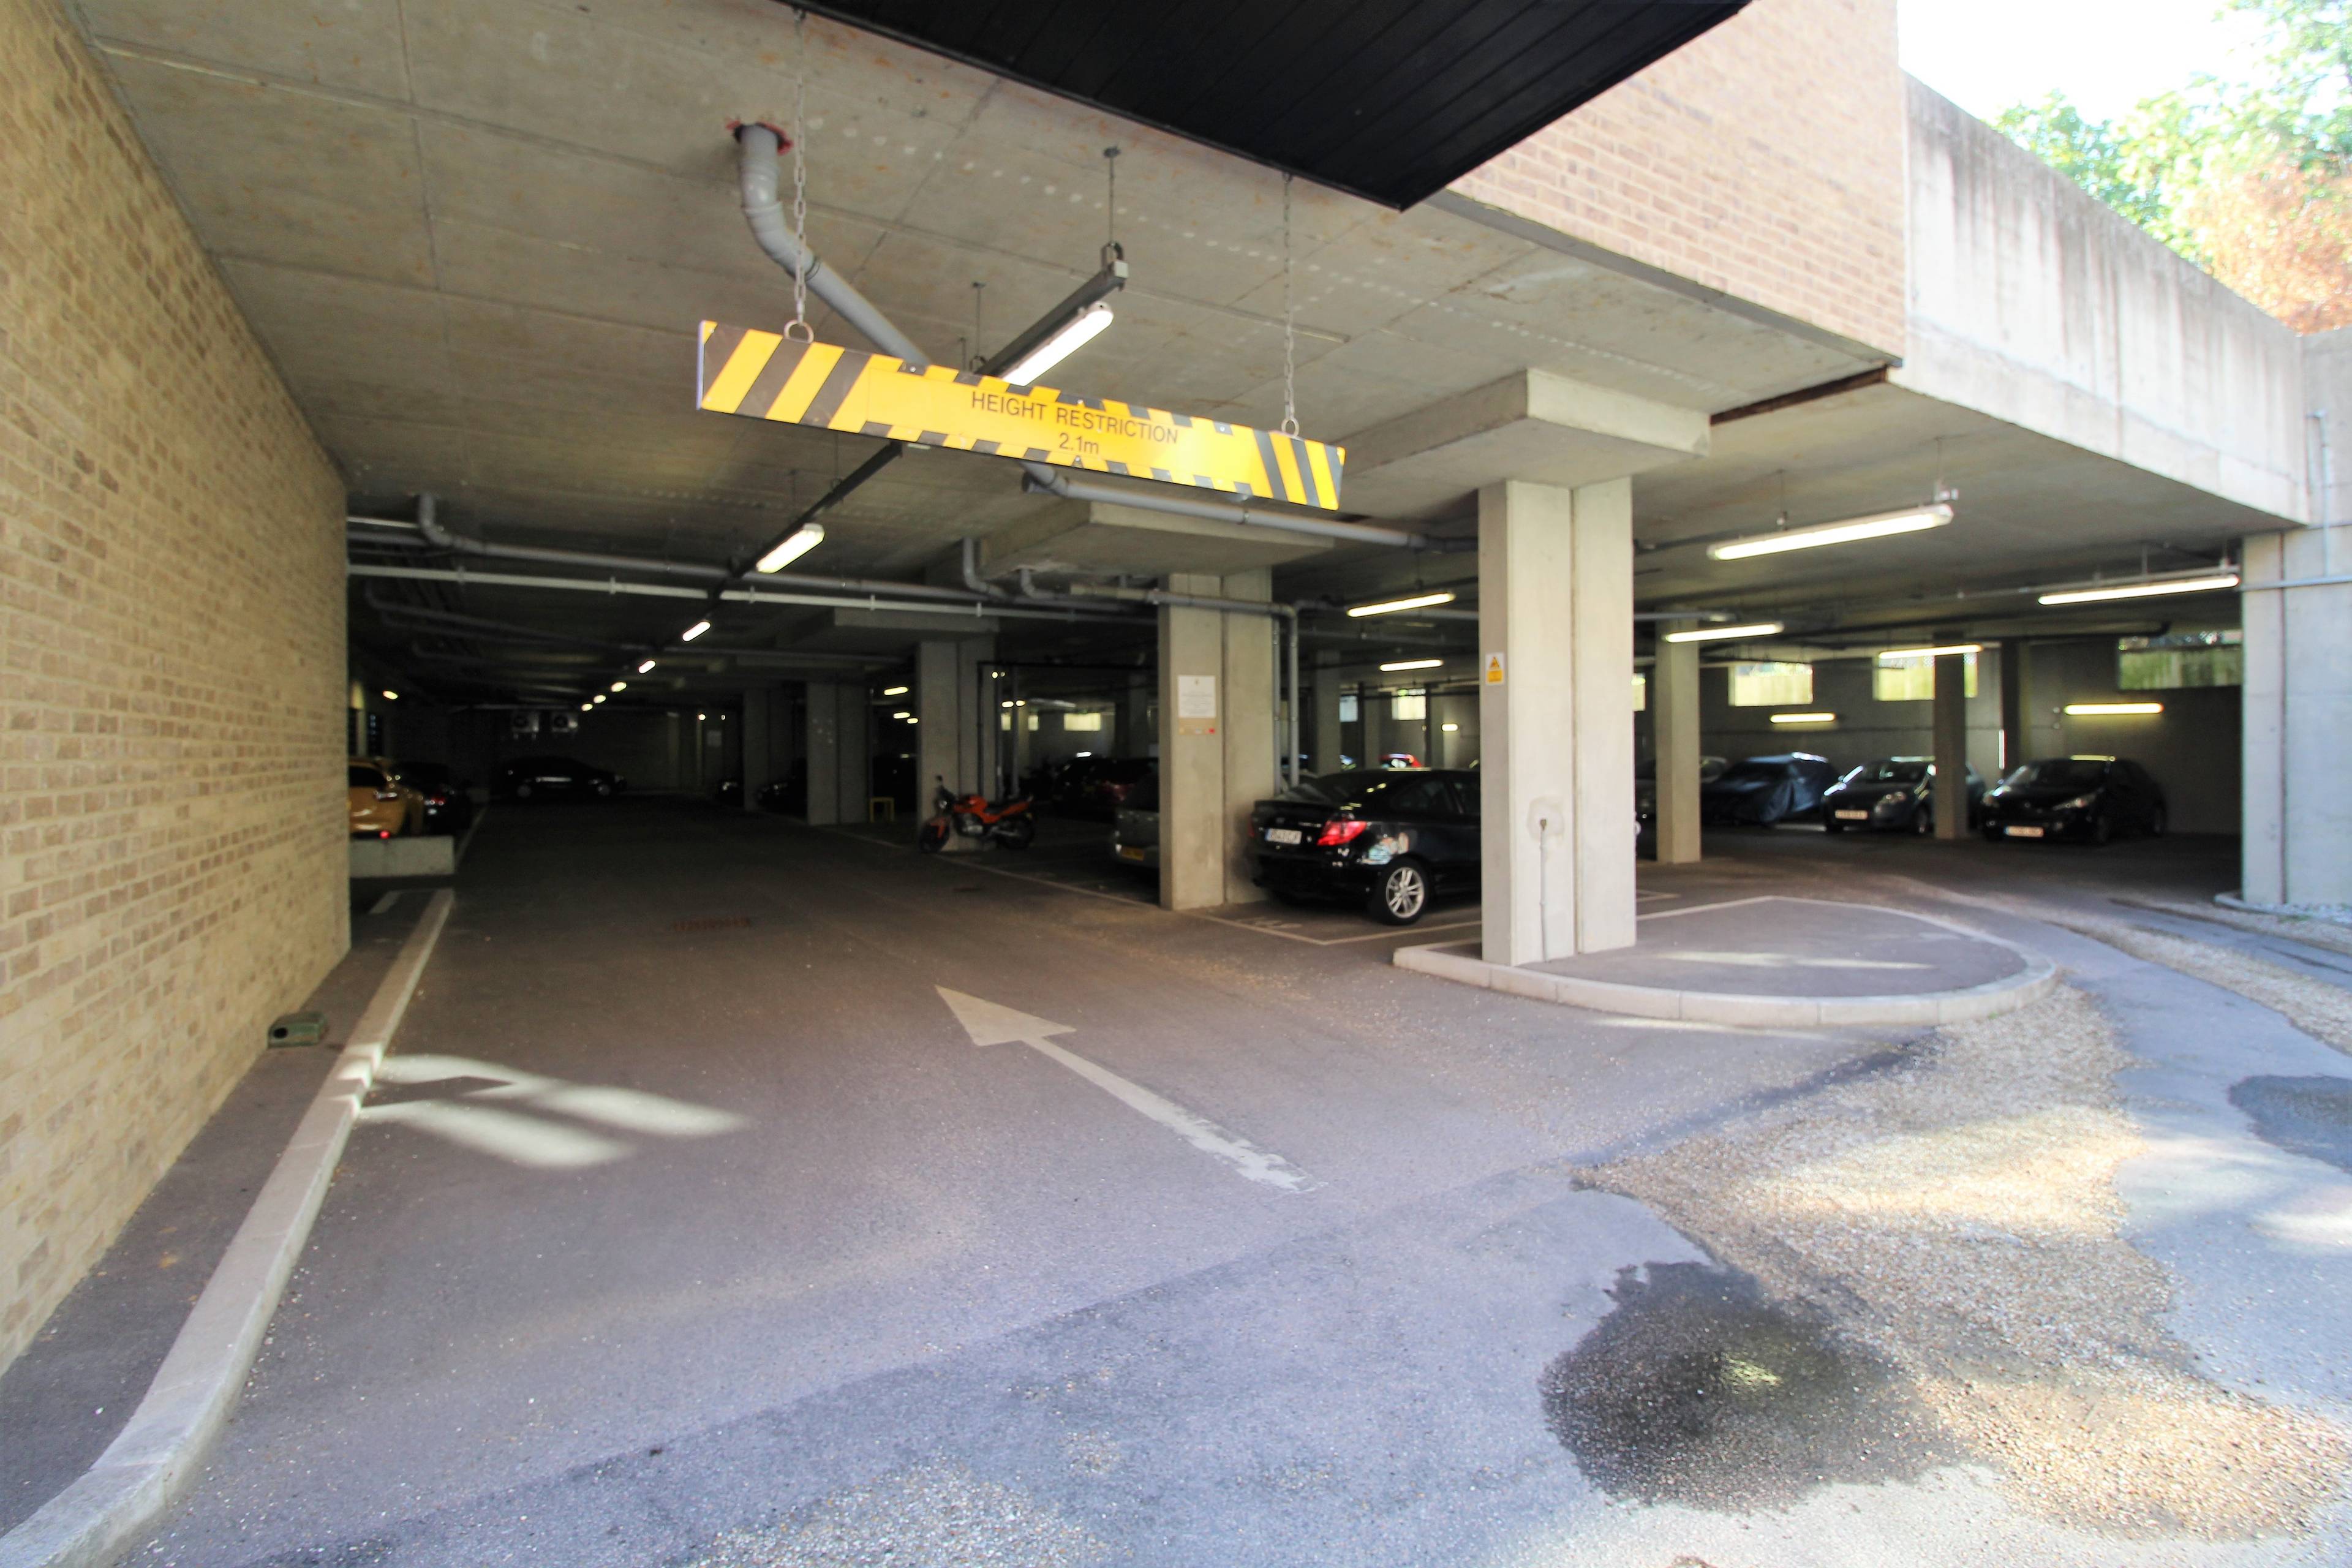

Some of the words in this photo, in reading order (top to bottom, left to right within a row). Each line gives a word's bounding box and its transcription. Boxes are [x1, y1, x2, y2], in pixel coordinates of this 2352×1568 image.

[972, 391, 1047, 420] HEIGHT
[1057, 407, 1178, 444] RESTRICTION
[1059, 433, 1099, 455] 2.1m
